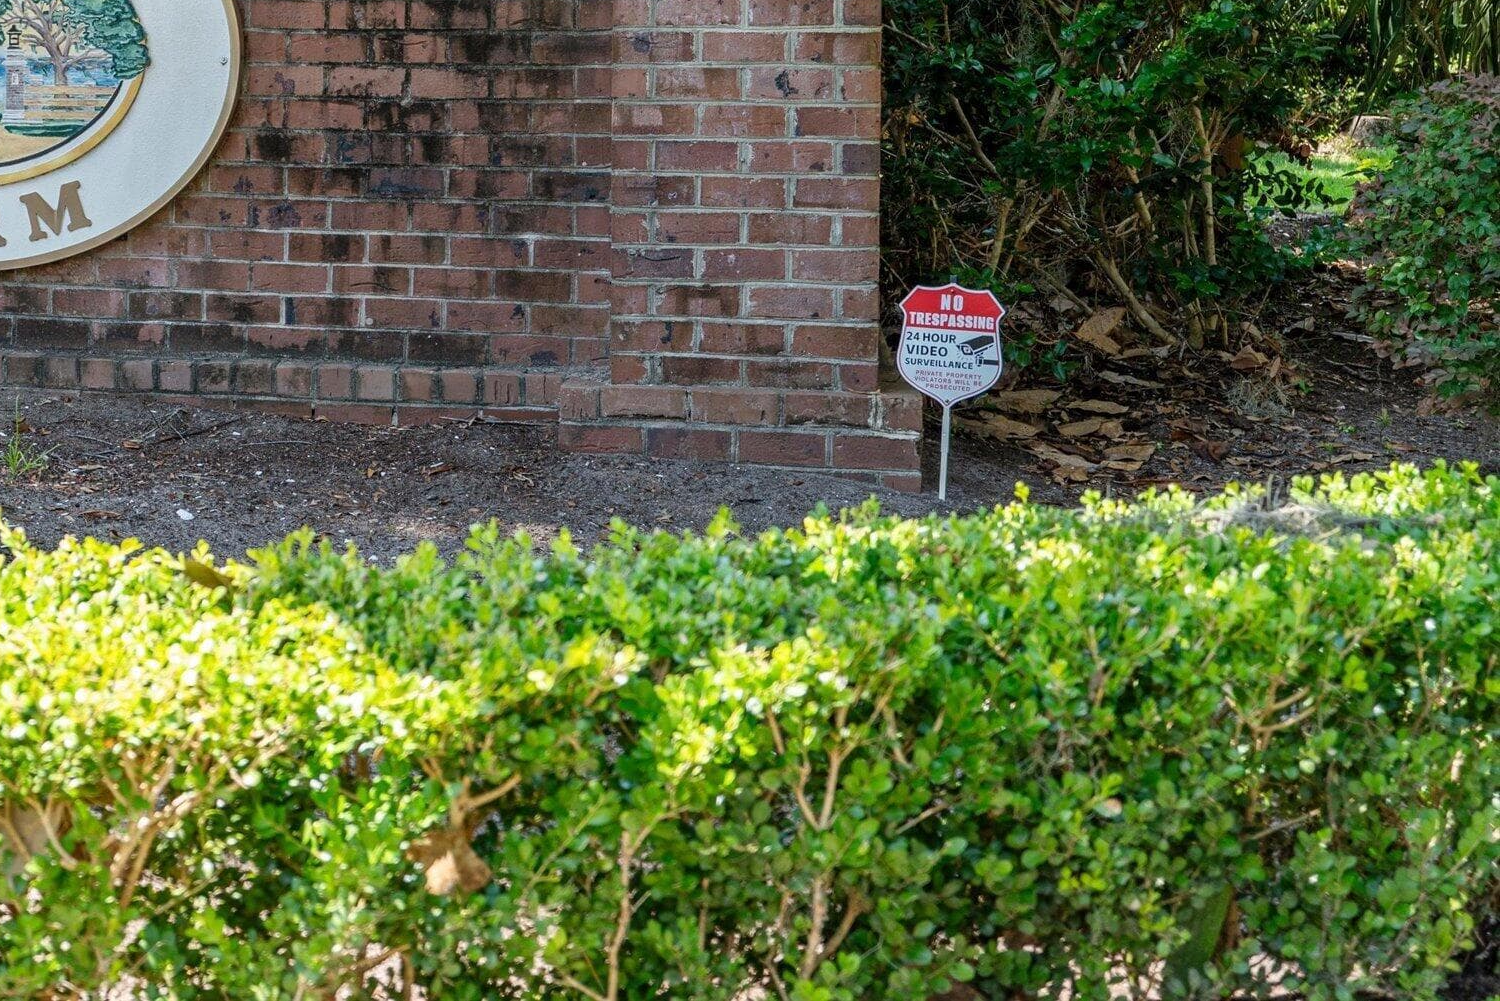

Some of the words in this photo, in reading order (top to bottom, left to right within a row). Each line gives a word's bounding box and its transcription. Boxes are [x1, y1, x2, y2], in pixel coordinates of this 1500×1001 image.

[940, 294, 964, 312] NO
[909, 311, 994, 330] TRESPASSING
[906, 331, 920, 341] 24
[922, 333, 956, 344] HOUR
[906, 344, 948, 357] VIDEO
[905, 357, 974, 370] SURVEILLANCE
[914, 376, 952, 384] VIOLATORS
[946, 371, 982, 380] PROPERTY
[925, 383, 971, 392] PROSECUTED
